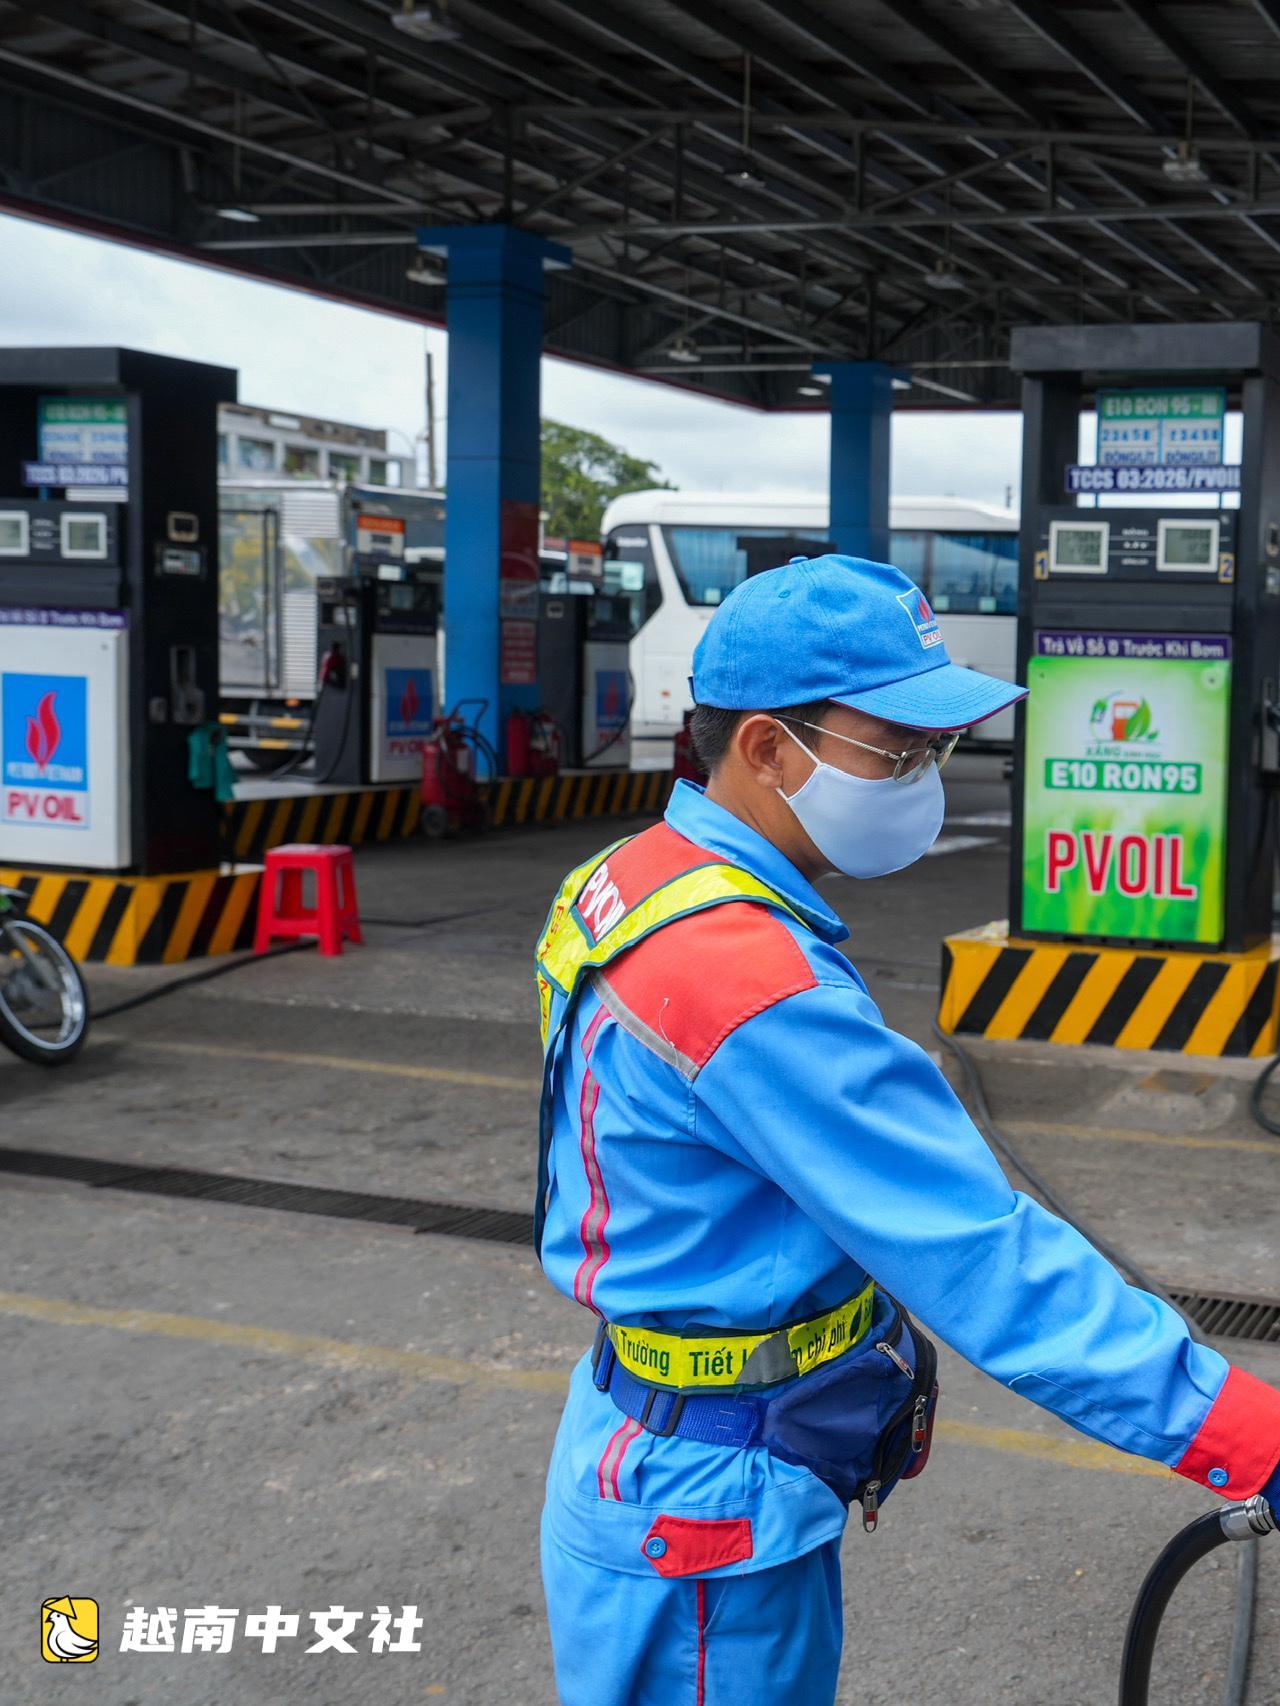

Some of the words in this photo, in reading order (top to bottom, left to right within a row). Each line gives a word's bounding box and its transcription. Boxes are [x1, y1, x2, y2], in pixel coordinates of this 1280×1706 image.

[1070, 469, 1114, 489] TCCS
[1051, 760, 1098, 788] E10
[1103, 762, 1198, 792] RON95
[1046, 830, 1196, 899] PVOIL
[620, 1329, 670, 1377] Trường
[688, 1346, 734, 1377] Tiết
[807, 1327, 826, 1360] chi
[828, 1315, 847, 1353] phí
